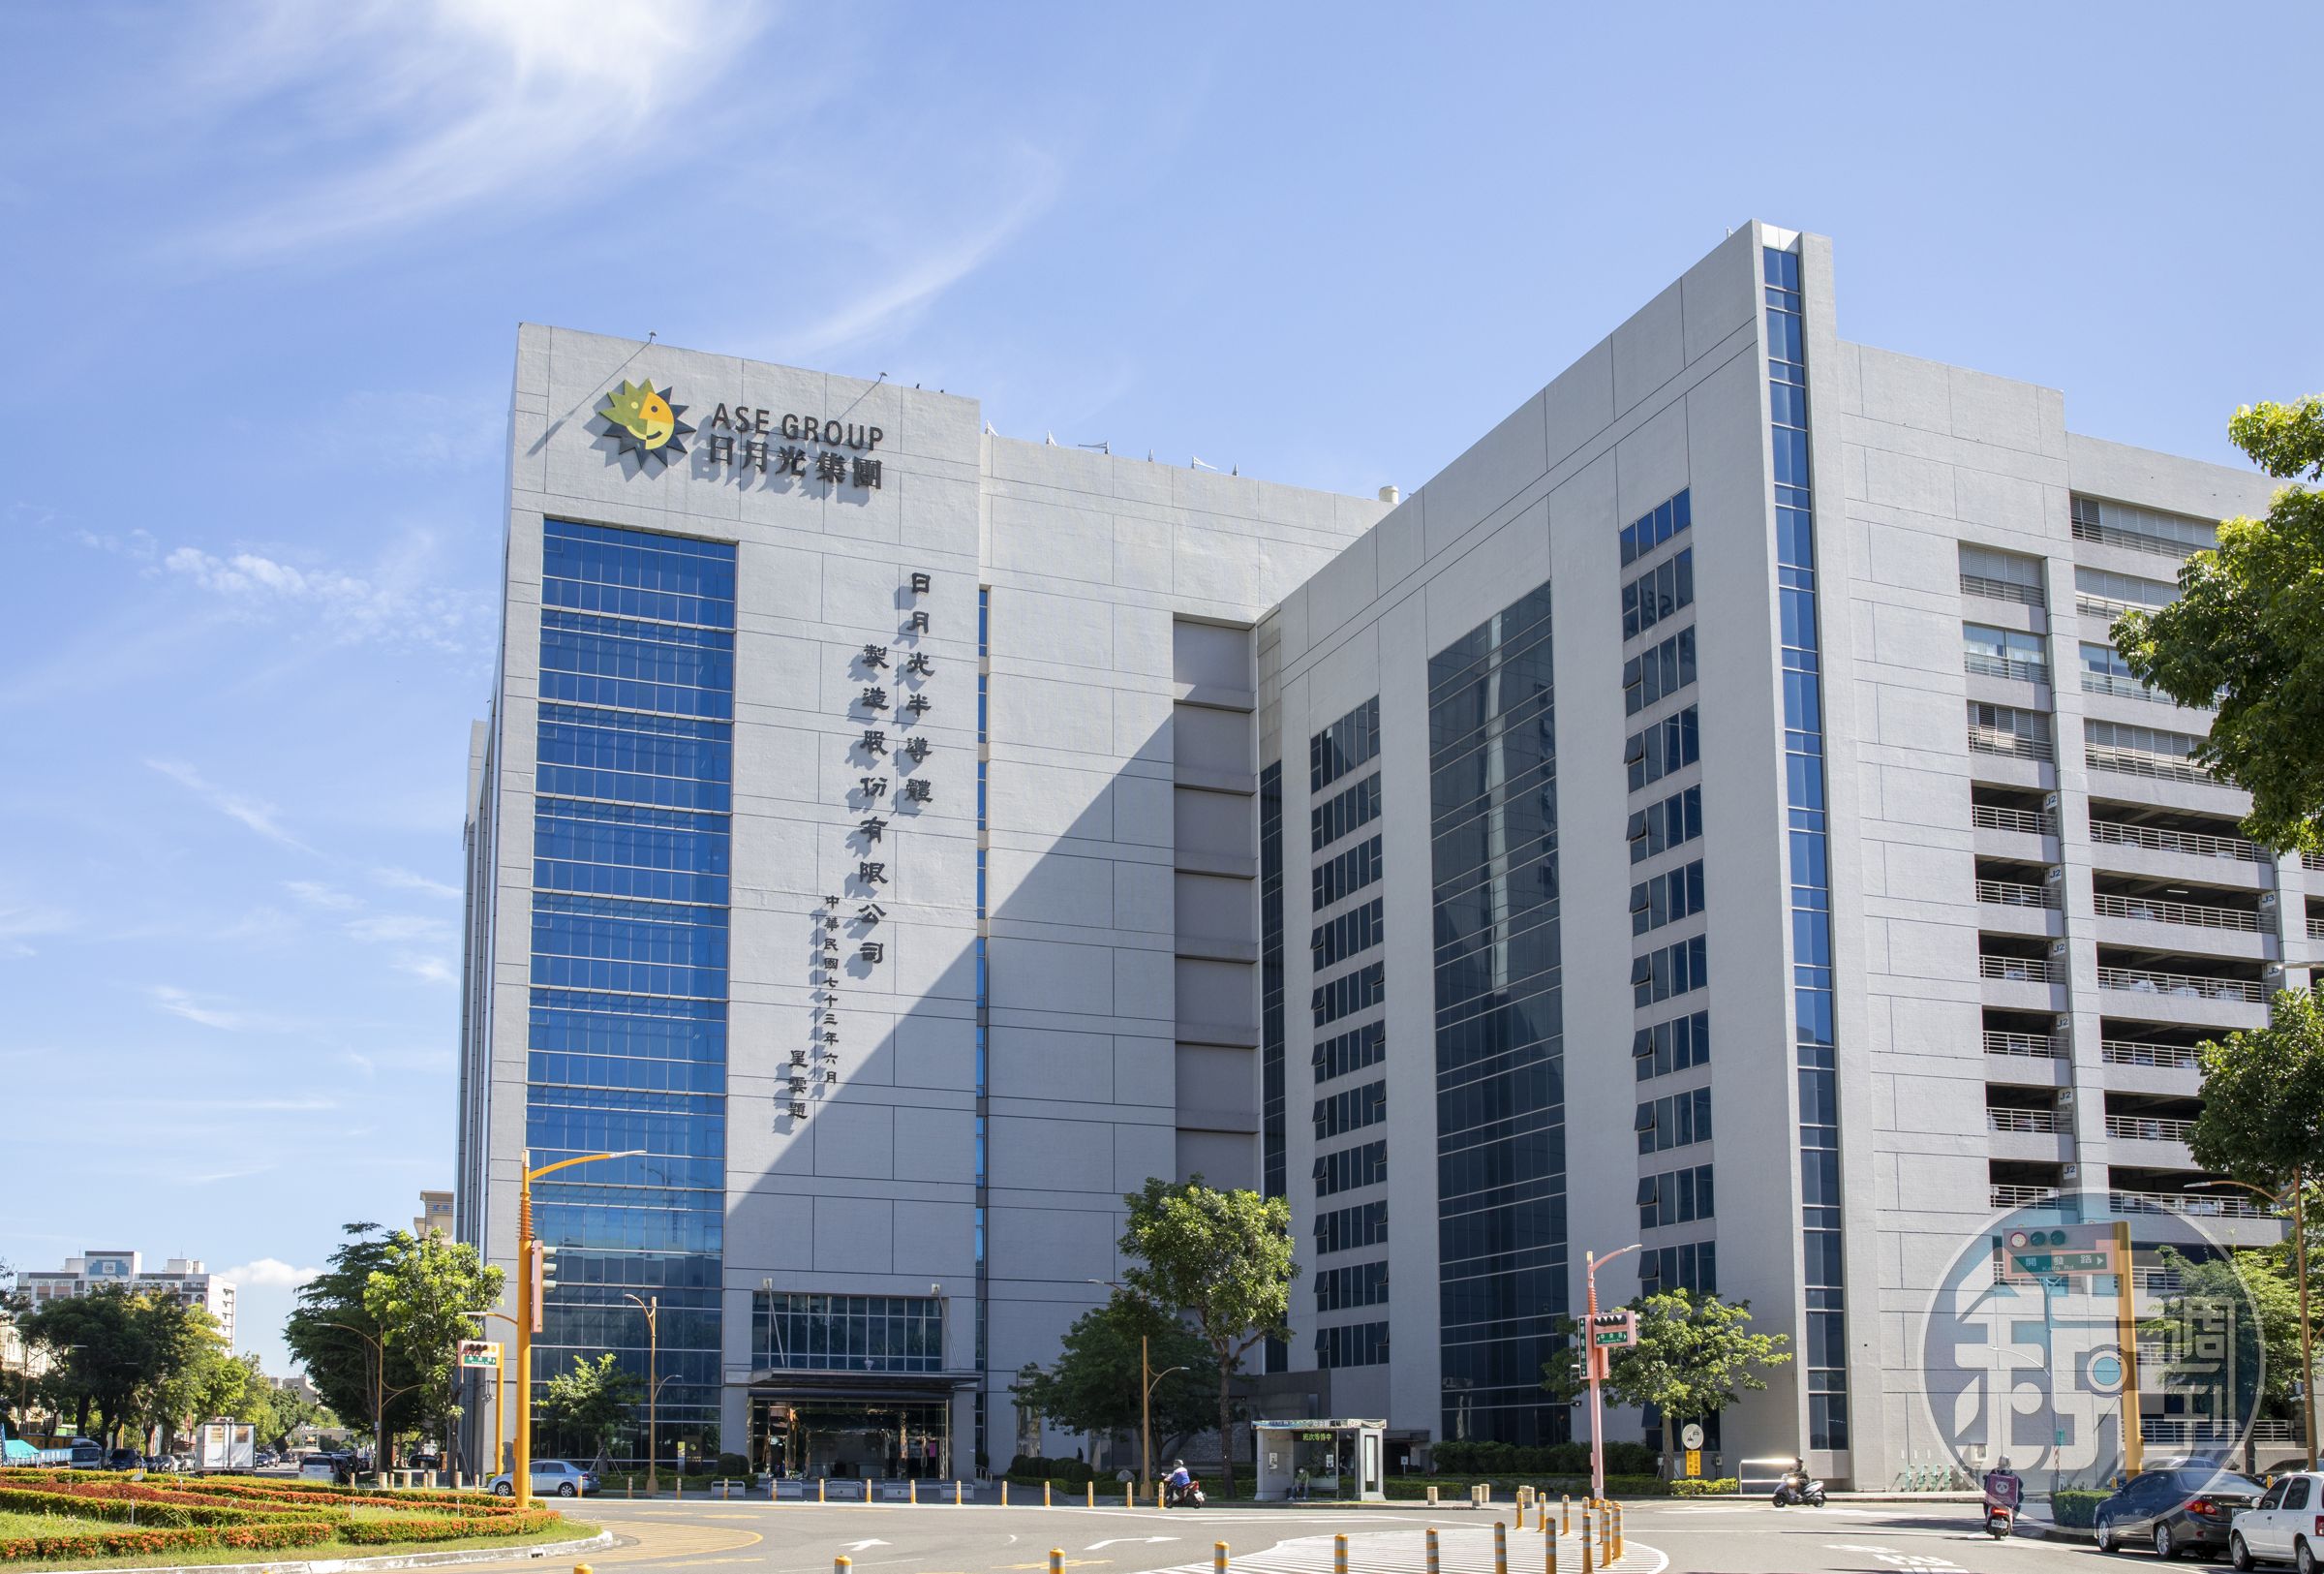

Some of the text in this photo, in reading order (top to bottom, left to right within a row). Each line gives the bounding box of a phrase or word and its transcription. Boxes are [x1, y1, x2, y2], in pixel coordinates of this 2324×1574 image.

[712, 403, 883, 451] ASE GROUP
[710, 434, 882, 490] 日月光集團
[905, 572, 934, 803] 日月光半導體
[859, 644, 889, 964] 製造股份有限公司
[2046, 795, 2057, 806] J2
[2050, 869, 2062, 879] J2
[2262, 894, 2275, 904] J3
[2054, 943, 2065, 953] J2
[824, 895, 840, 1086] 中華民國七十三年六月
[2057, 1018, 2068, 1028] J2
[2060, 1091, 2072, 1100] J2
[2064, 1165, 2076, 1175] J2
